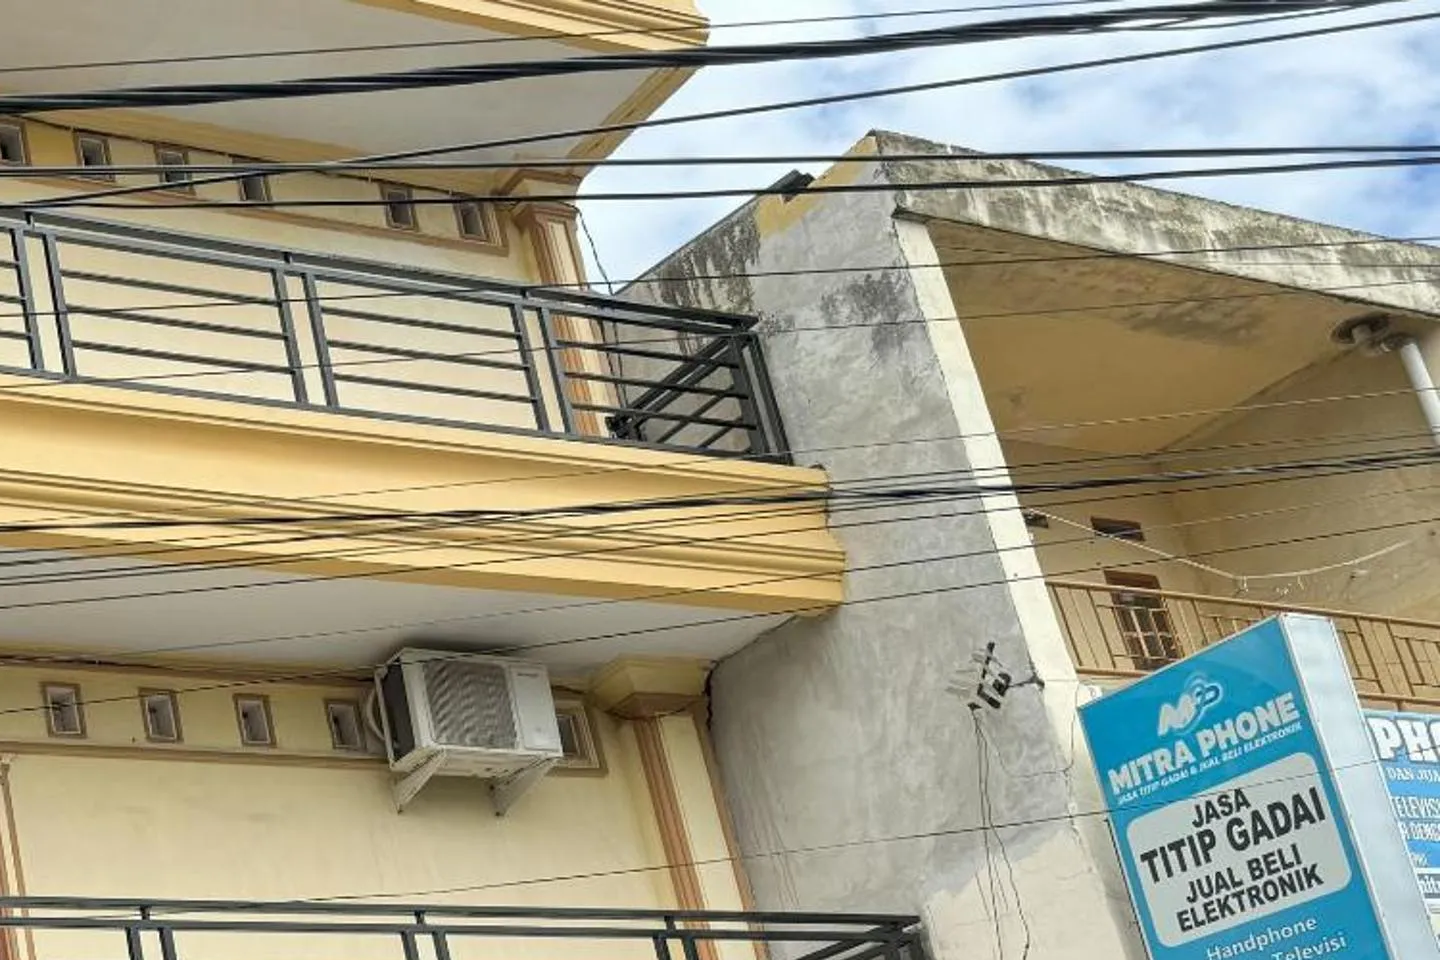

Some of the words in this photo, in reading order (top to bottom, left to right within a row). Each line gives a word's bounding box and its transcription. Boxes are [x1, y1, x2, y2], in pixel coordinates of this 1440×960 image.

[1108, 740, 1196, 796] MITRA
[1196, 692, 1300, 758] PHONE
[1140, 829, 1216, 884] TITIP
[1226, 787, 1326, 851] GADAI
[1192, 788, 1251, 827] JASA
[1176, 864, 1324, 932] ELEKTRONIK
[1186, 867, 1244, 903] JUAL
[1247, 843, 1302, 880] BELI
